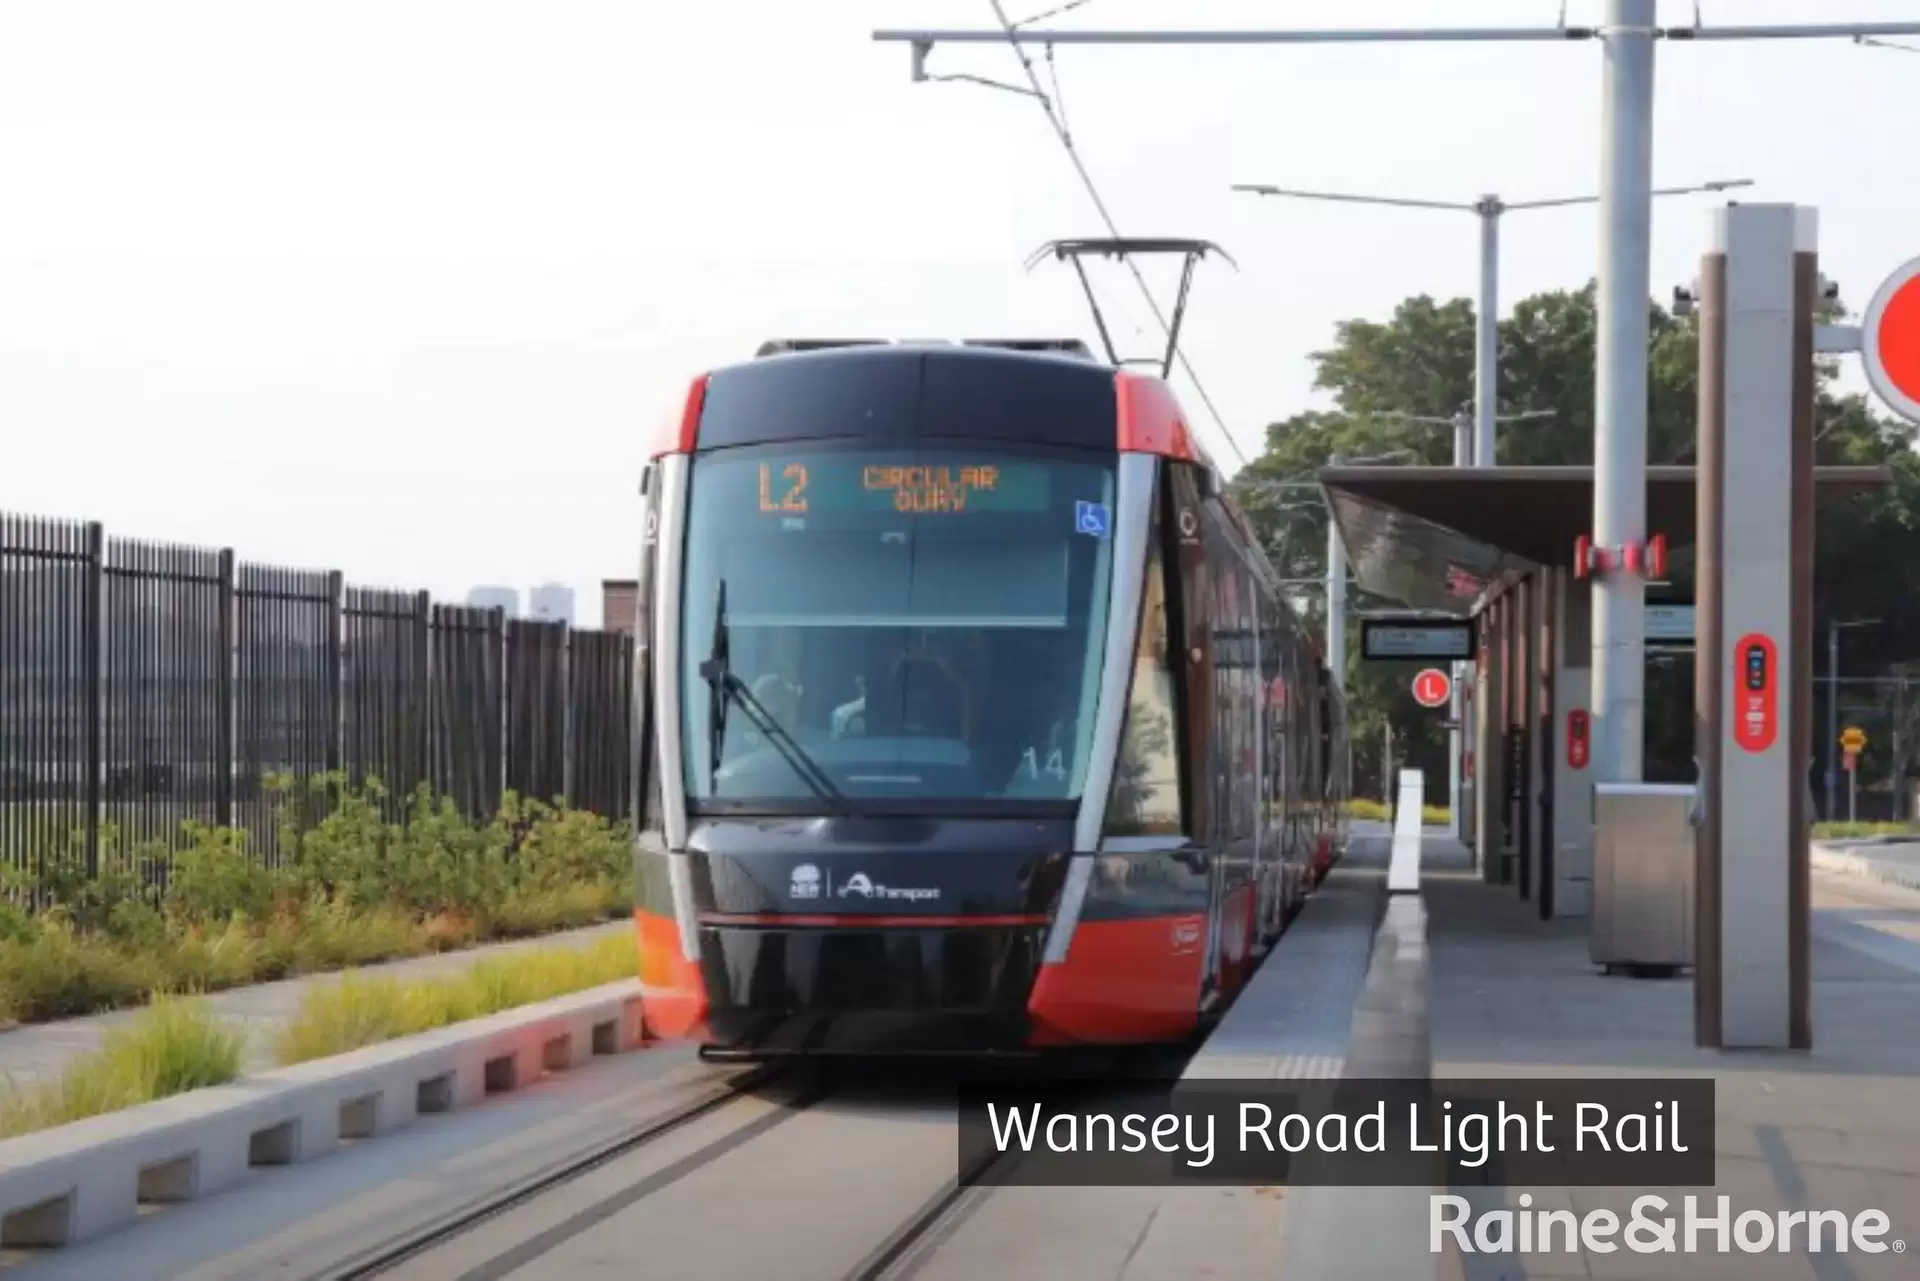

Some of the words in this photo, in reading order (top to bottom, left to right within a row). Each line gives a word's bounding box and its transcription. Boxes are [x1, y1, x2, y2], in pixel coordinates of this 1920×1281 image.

[758, 462, 809, 512] L2
[863, 464, 999, 490] CIRCULAR
[1424, 677, 1440, 699] L
[1022, 745, 1067, 782] 14
